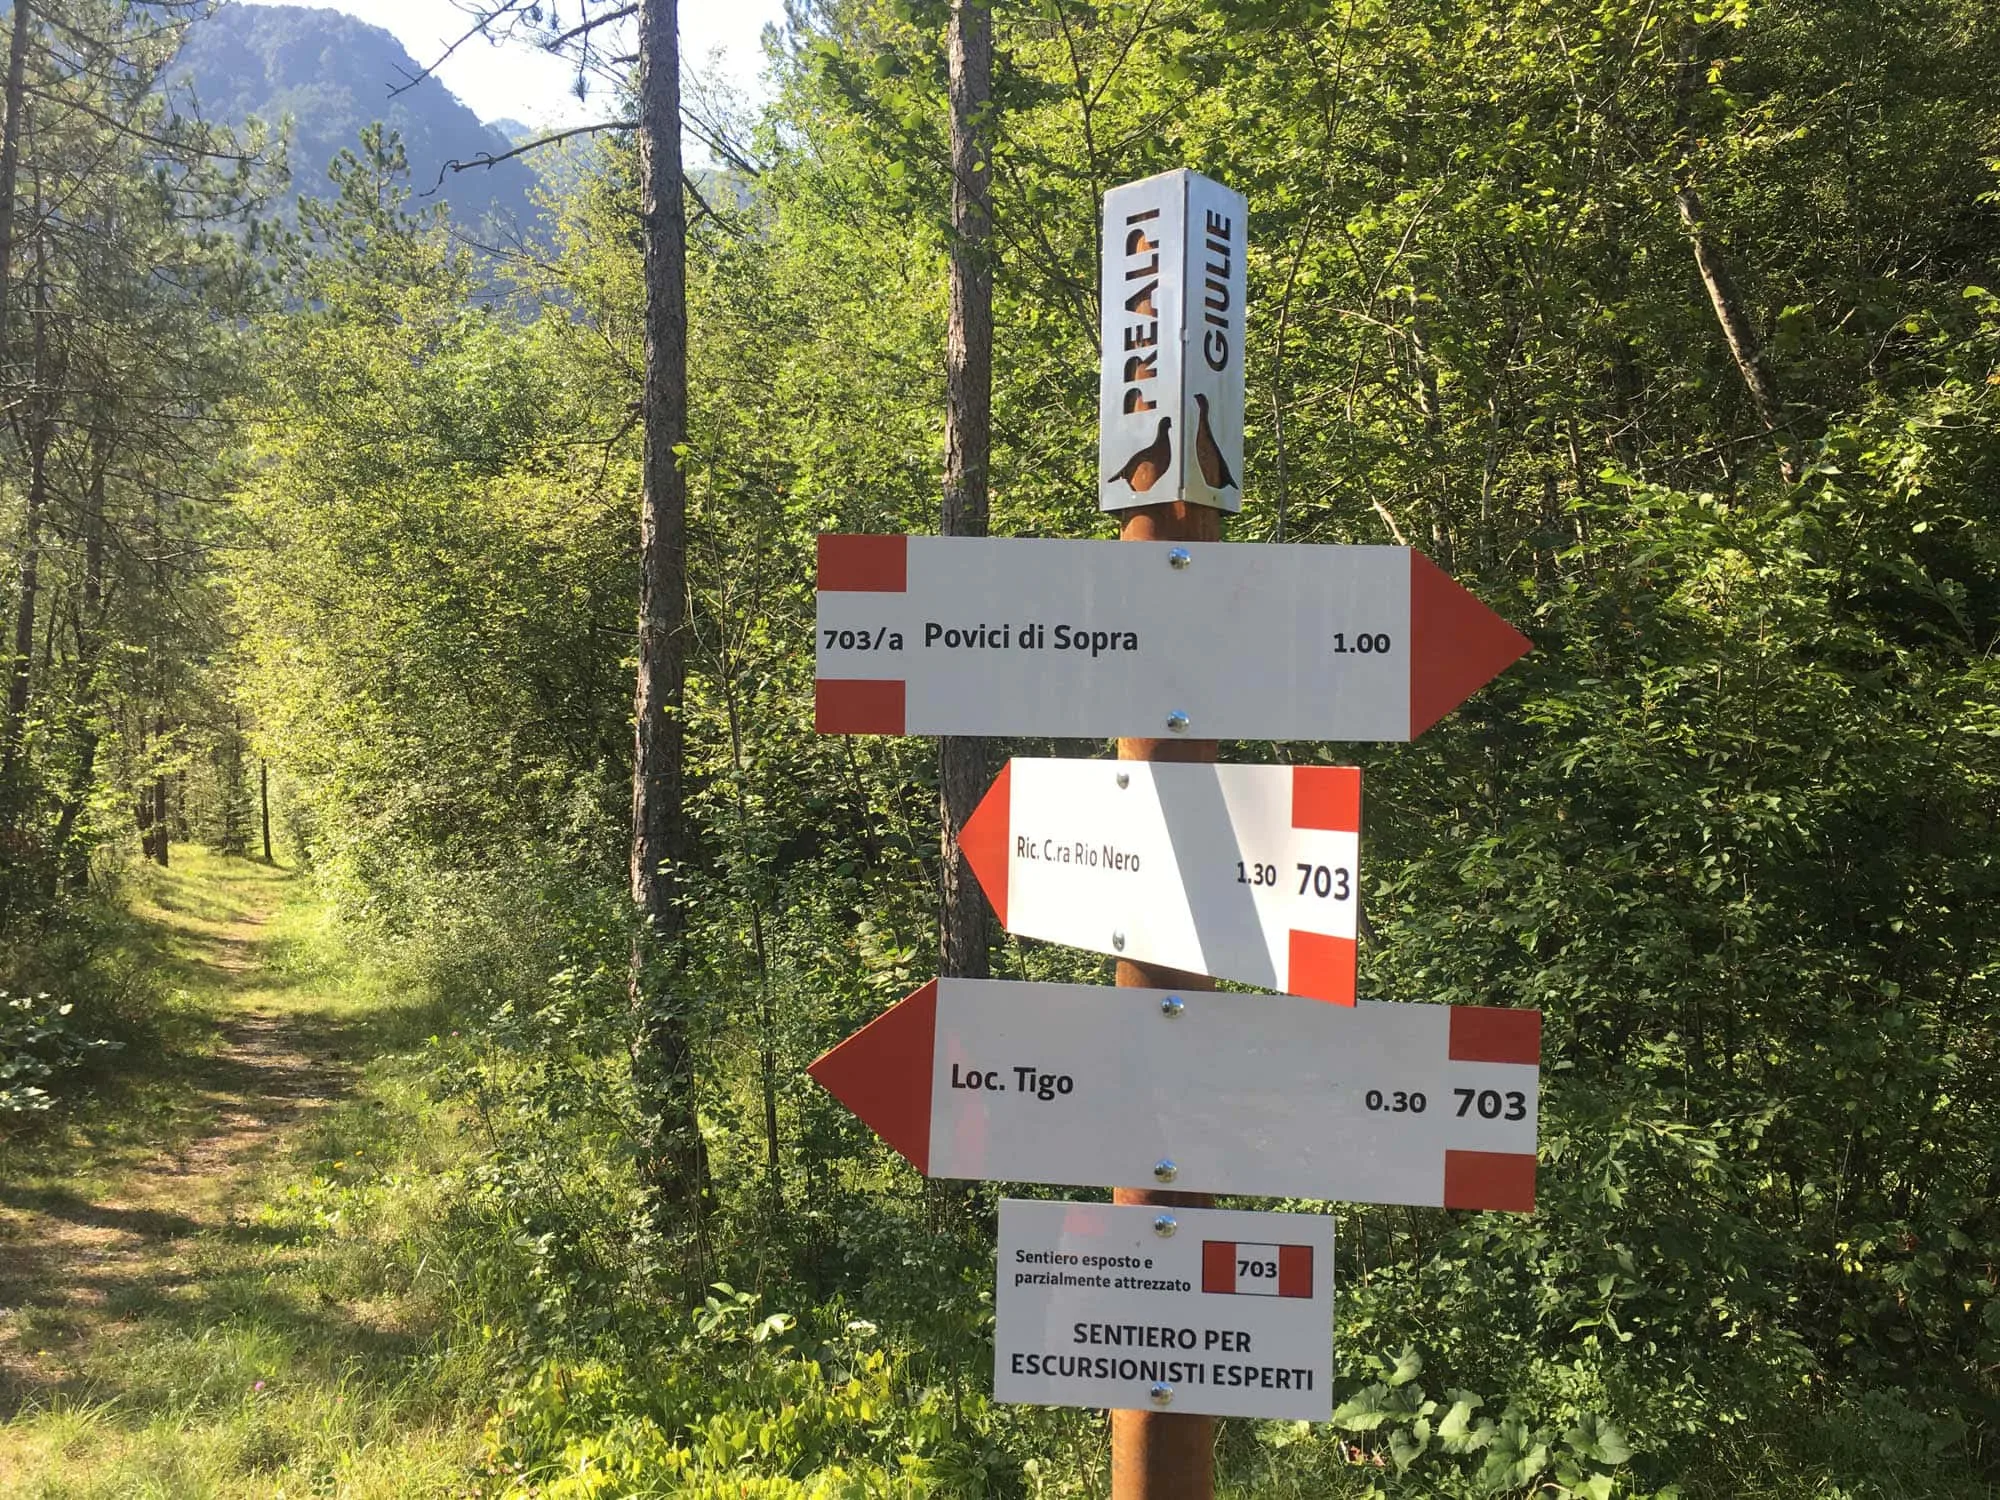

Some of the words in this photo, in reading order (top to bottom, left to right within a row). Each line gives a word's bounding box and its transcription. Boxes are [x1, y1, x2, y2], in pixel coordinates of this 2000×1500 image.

[1204, 209, 1231, 372] GIULIE
[1123, 208, 1160, 414] PREALPI
[823, 627, 904, 651] 703/a
[924, 622, 1012, 650] Povici
[1018, 623, 1044, 650] di
[1053, 624, 1139, 658] Sopra
[1332, 632, 1391, 655] 1.00
[1017, 835, 1040, 860] Ric.
[1044, 839, 1070, 863] C.ra
[1075, 842, 1097, 867] Rio
[1102, 846, 1140, 873] Nero
[1237, 862, 1276, 887] 1.30
[1297, 863, 1350, 900] 703
[951, 1064, 1006, 1092] Loc.
[1014, 1067, 1074, 1101] Tigo
[1365, 1089, 1427, 1114] 0.30
[1453, 1088, 1527, 1121] 703
[1015, 1250, 1078, 1266] Sentiero
[1082, 1254, 1140, 1272] esposto
[1144, 1258, 1153, 1269] e
[1237, 1260, 1278, 1278] 703
[1015, 1271, 1111, 1289] parzialmente
[1114, 1276, 1191, 1292] attrezzato
[1073, 1323, 1197, 1350] SENTIERO
[1204, 1330, 1251, 1352] PER
[1011, 1353, 1205, 1384] ESCURSIONISTI
[1213, 1363, 1313, 1391] ESPERTI
